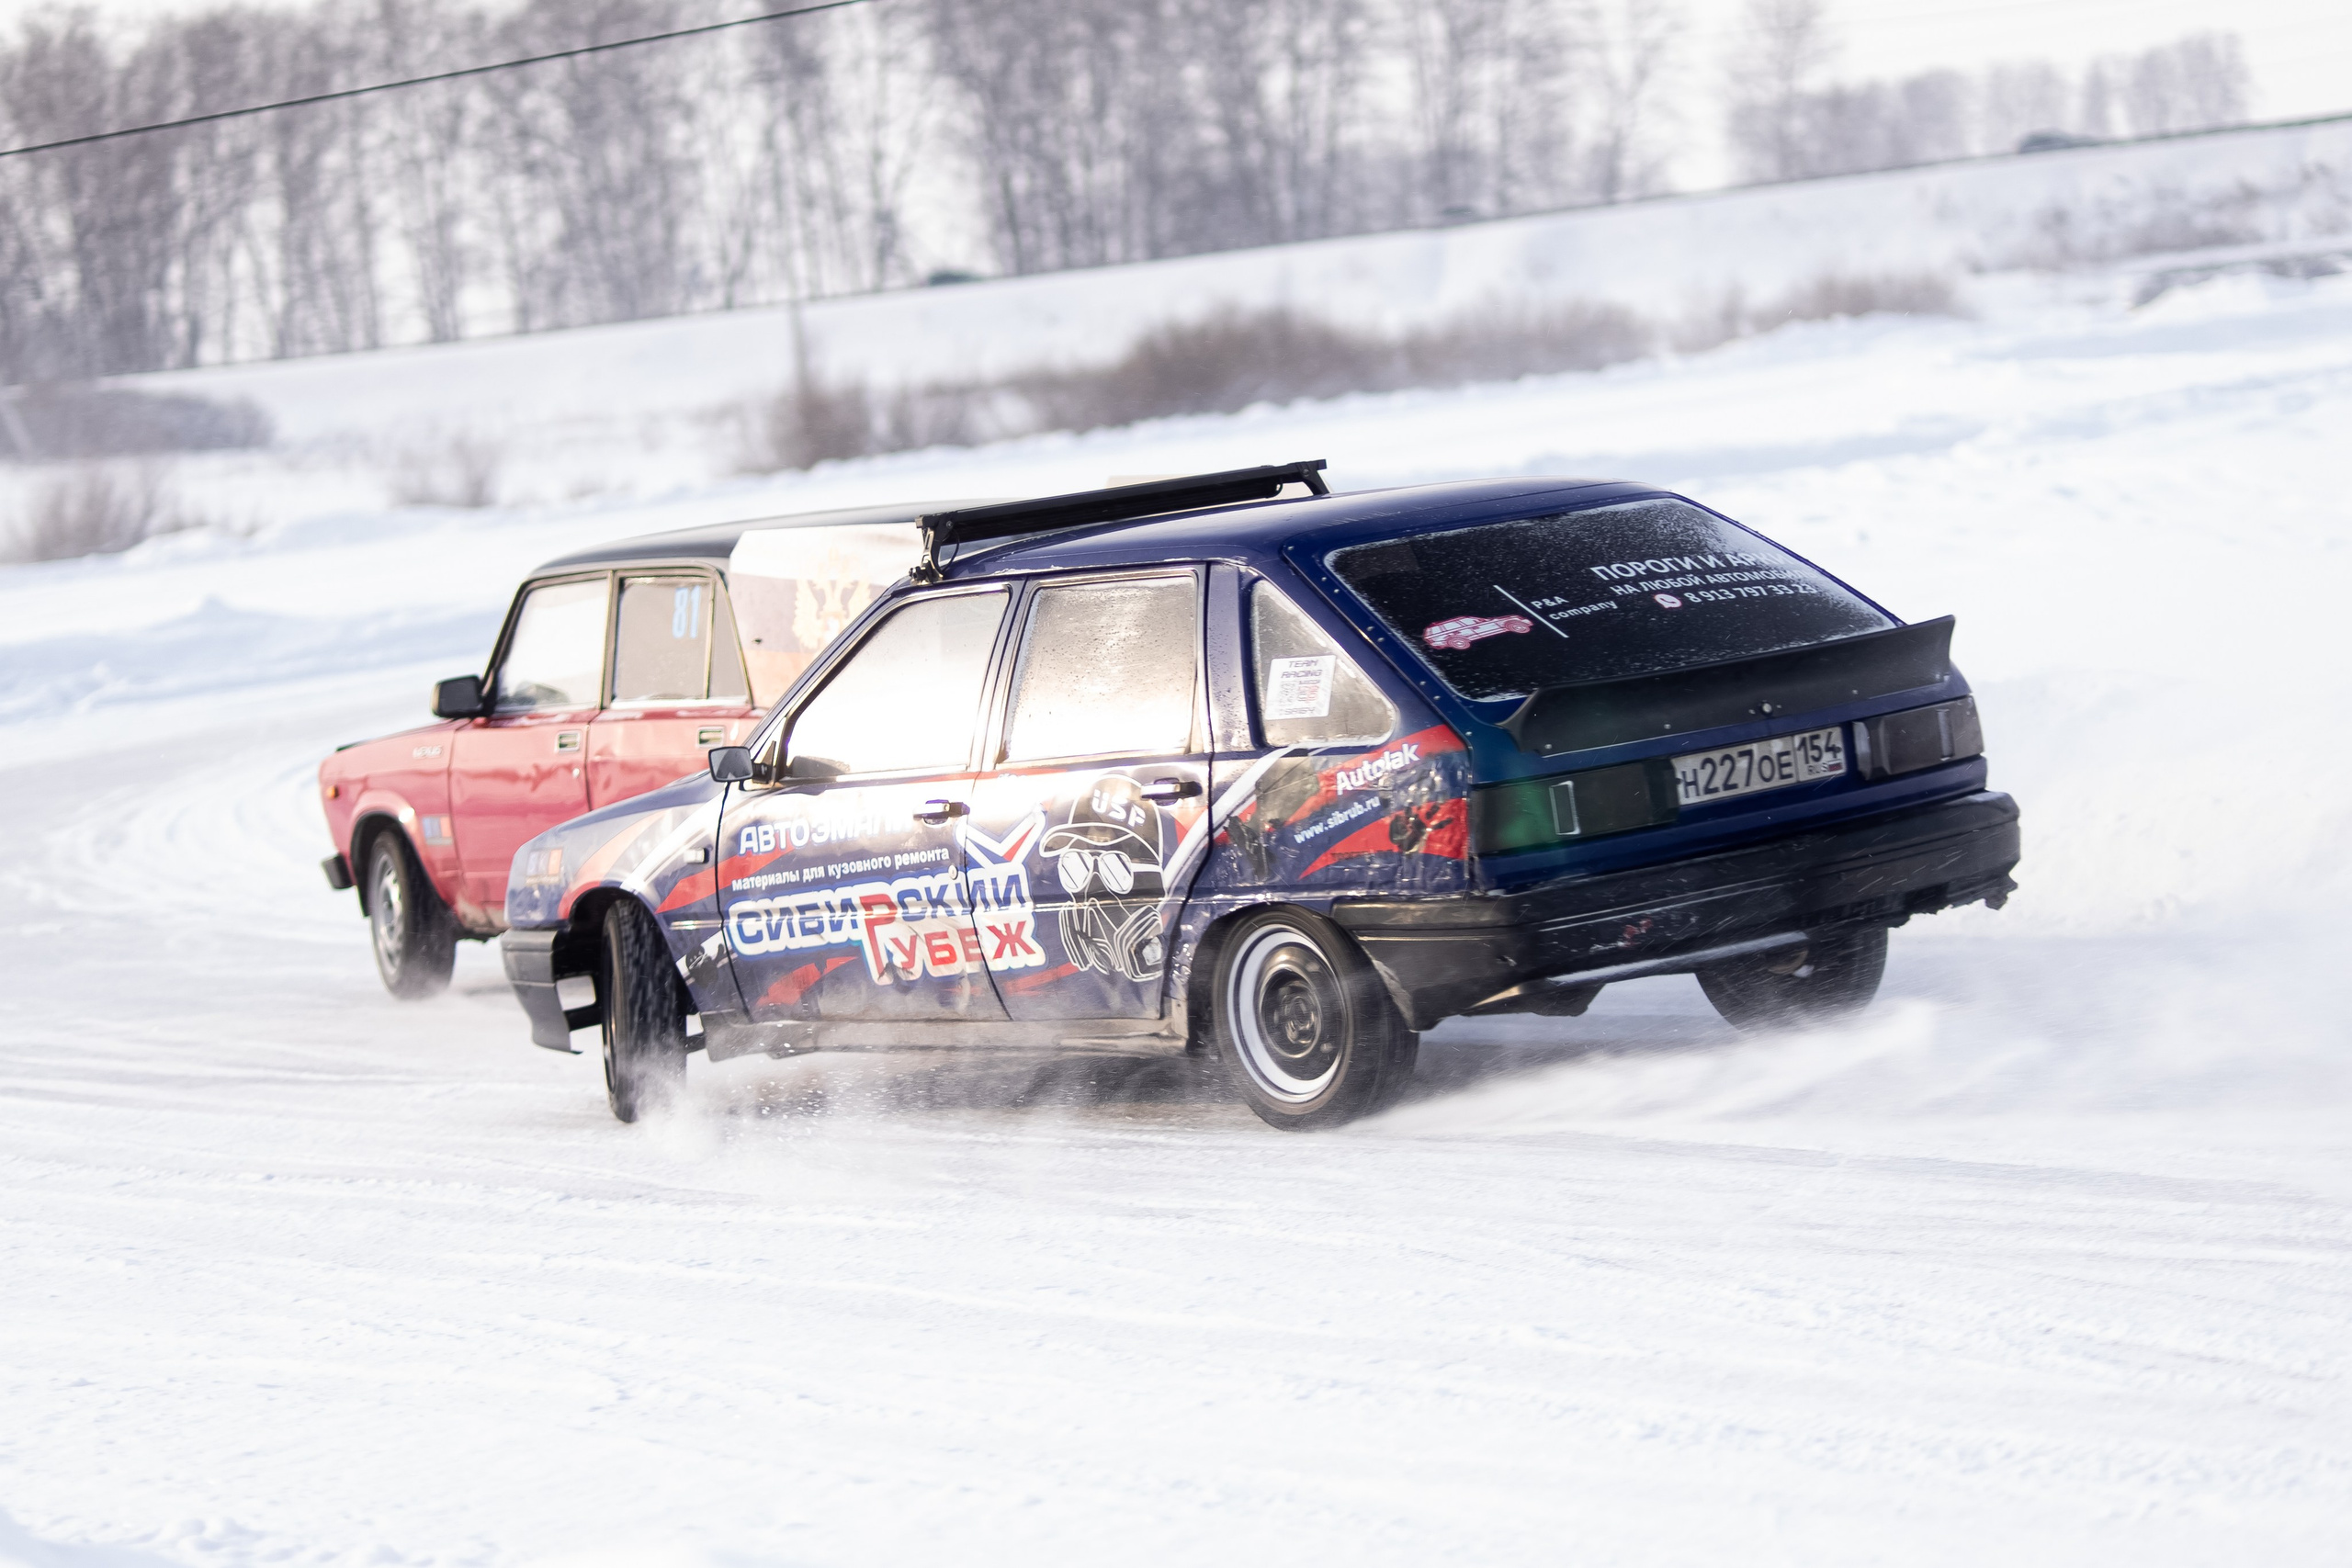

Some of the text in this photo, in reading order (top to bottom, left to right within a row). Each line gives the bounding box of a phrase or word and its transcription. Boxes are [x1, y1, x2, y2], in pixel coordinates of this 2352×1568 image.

[1589, 555, 1702, 581] ПОРОГИ
[1700, 554, 1724, 570] И
[1610, 582, 1641, 597] НА
[1639, 574, 1705, 594] ЛЮБОЙ
[1683, 583, 1818, 604] 8 913 797 33 23
[673, 585, 701, 639] 81
[1531, 595, 1569, 610] P&A
[1548, 600, 1619, 621] company
[1280, 669, 1324, 679] RACING
[1289, 659, 1319, 669] TEAM
[1797, 731, 1838, 765] 154
[1336, 743, 1420, 795] Autolak
[1294, 796, 1382, 844] www.sibrub.ru
[731, 847, 950, 892] материалы для кузовного ремонта
